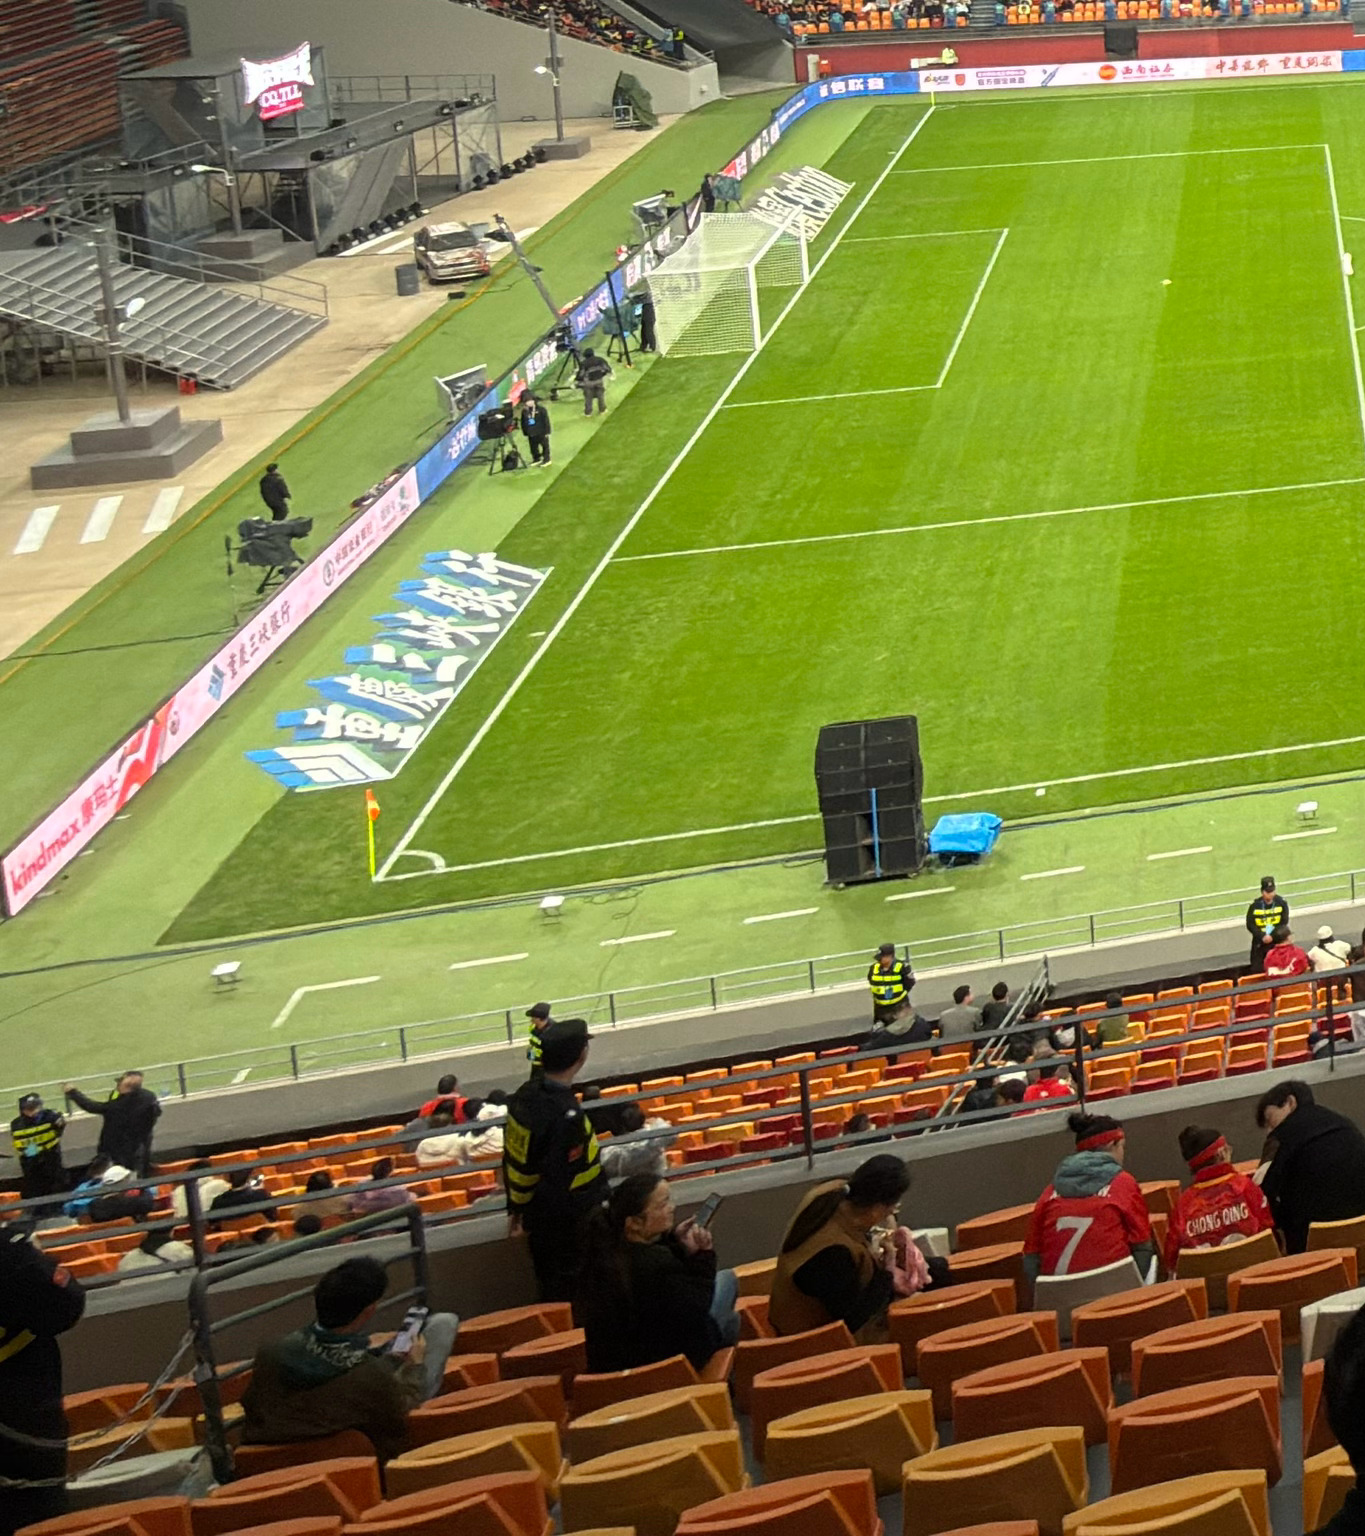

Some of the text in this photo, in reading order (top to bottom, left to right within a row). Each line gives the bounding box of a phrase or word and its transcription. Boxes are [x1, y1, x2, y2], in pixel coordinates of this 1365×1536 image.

[10, 818, 83, 896] kindmax
[1053, 1215, 1095, 1276] 7
[1185, 1201, 1250, 1238] CHONG QING
